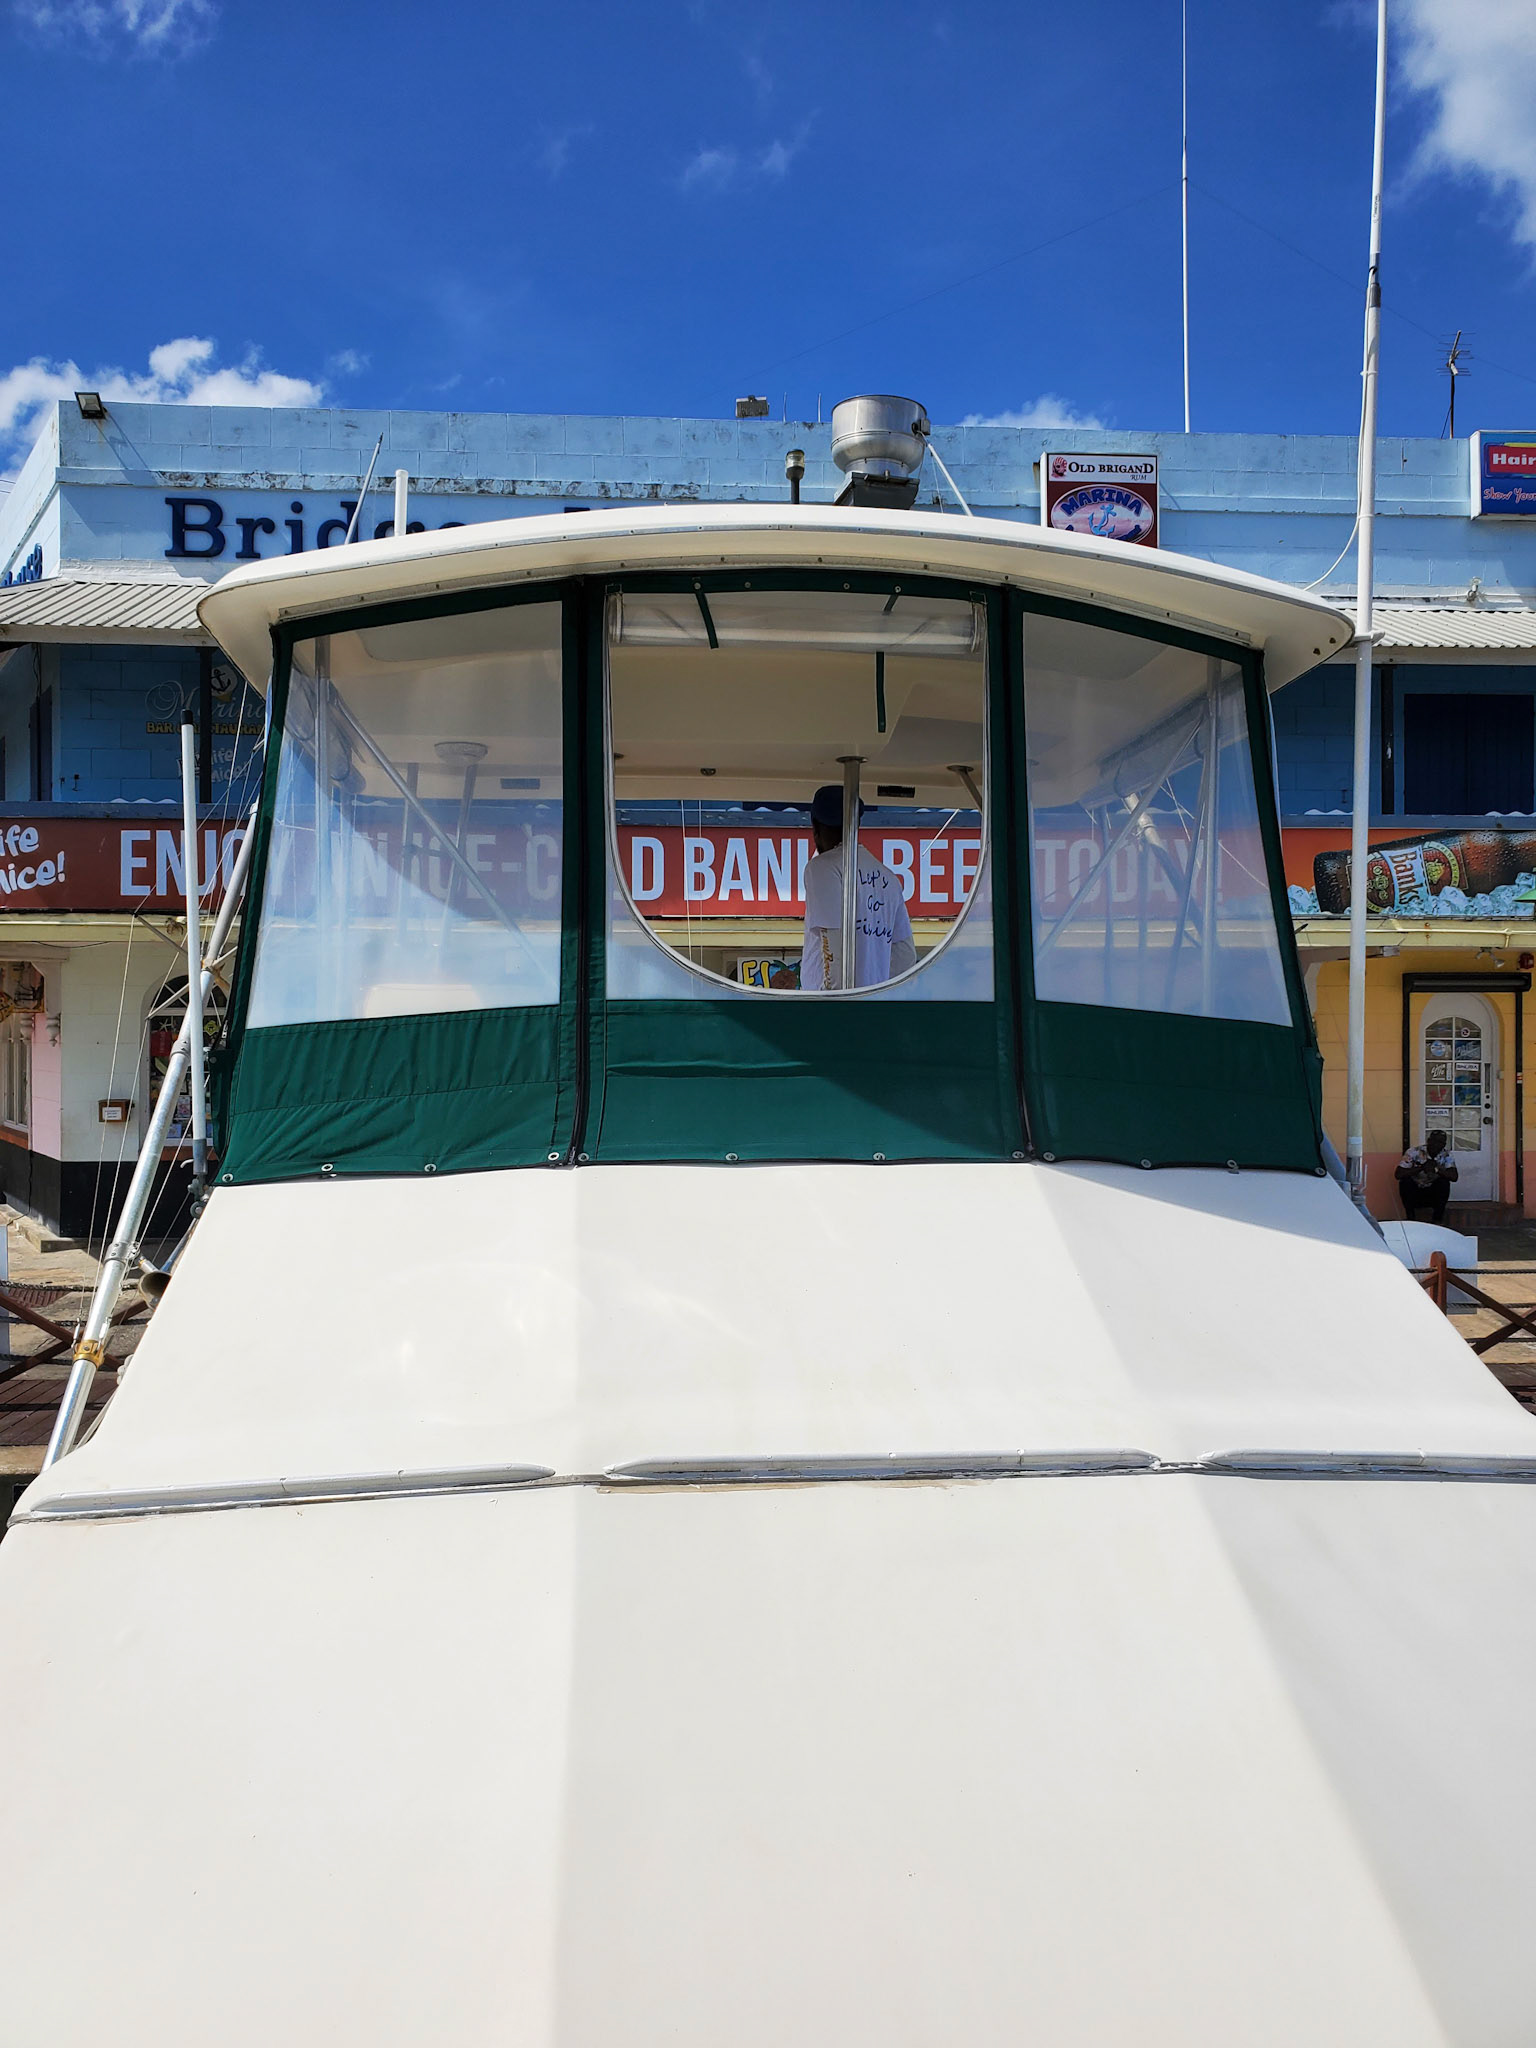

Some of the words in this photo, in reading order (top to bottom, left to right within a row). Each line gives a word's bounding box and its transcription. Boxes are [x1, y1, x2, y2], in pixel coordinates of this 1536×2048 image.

[1068, 461, 1095, 473] OLD
[1098, 463, 1154, 474] BRIGAND
[1060, 488, 1144, 517] MARINA
[165, 497, 467, 559] Brid
[146, 721, 174, 734] BAR
[882, 838, 983, 904] BEE
[867, 894, 885, 913] Go
